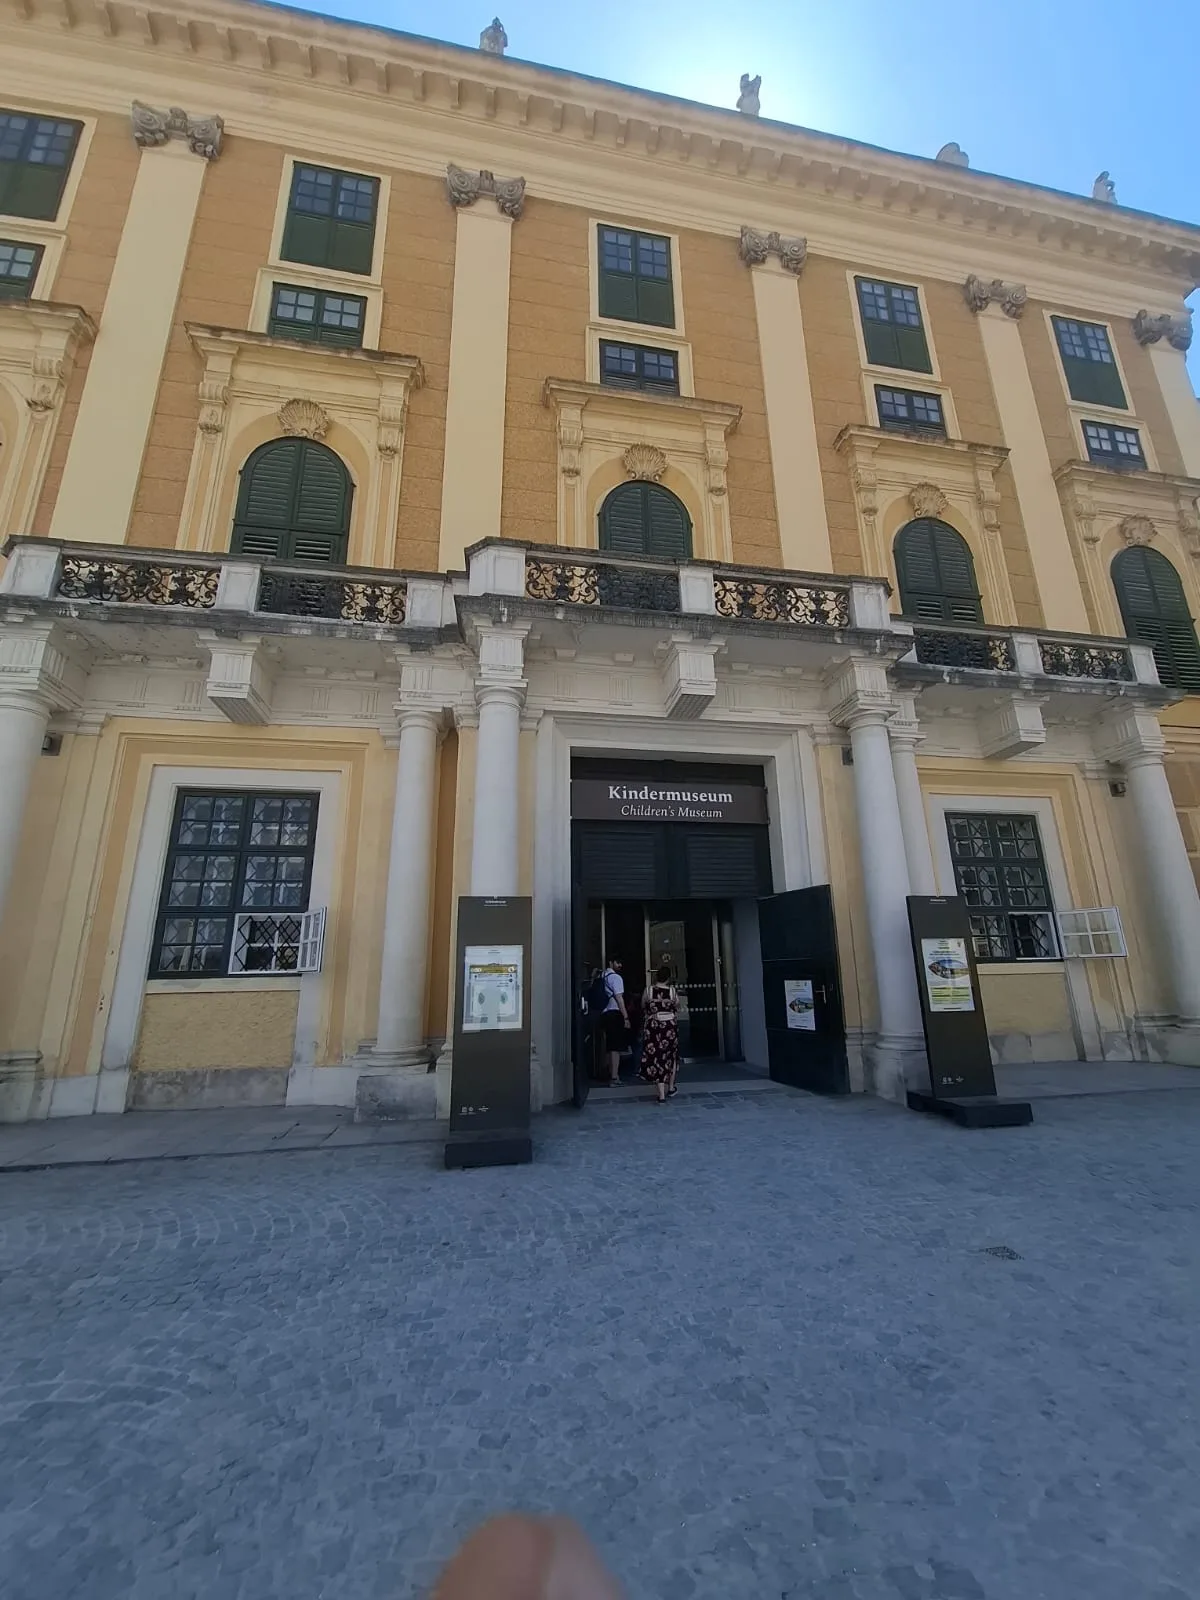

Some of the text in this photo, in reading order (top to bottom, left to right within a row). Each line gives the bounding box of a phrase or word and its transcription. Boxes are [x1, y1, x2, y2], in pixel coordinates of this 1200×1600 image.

[608, 785, 733, 803] Kindermuseum
[621, 804, 723, 818] Children's Museum
